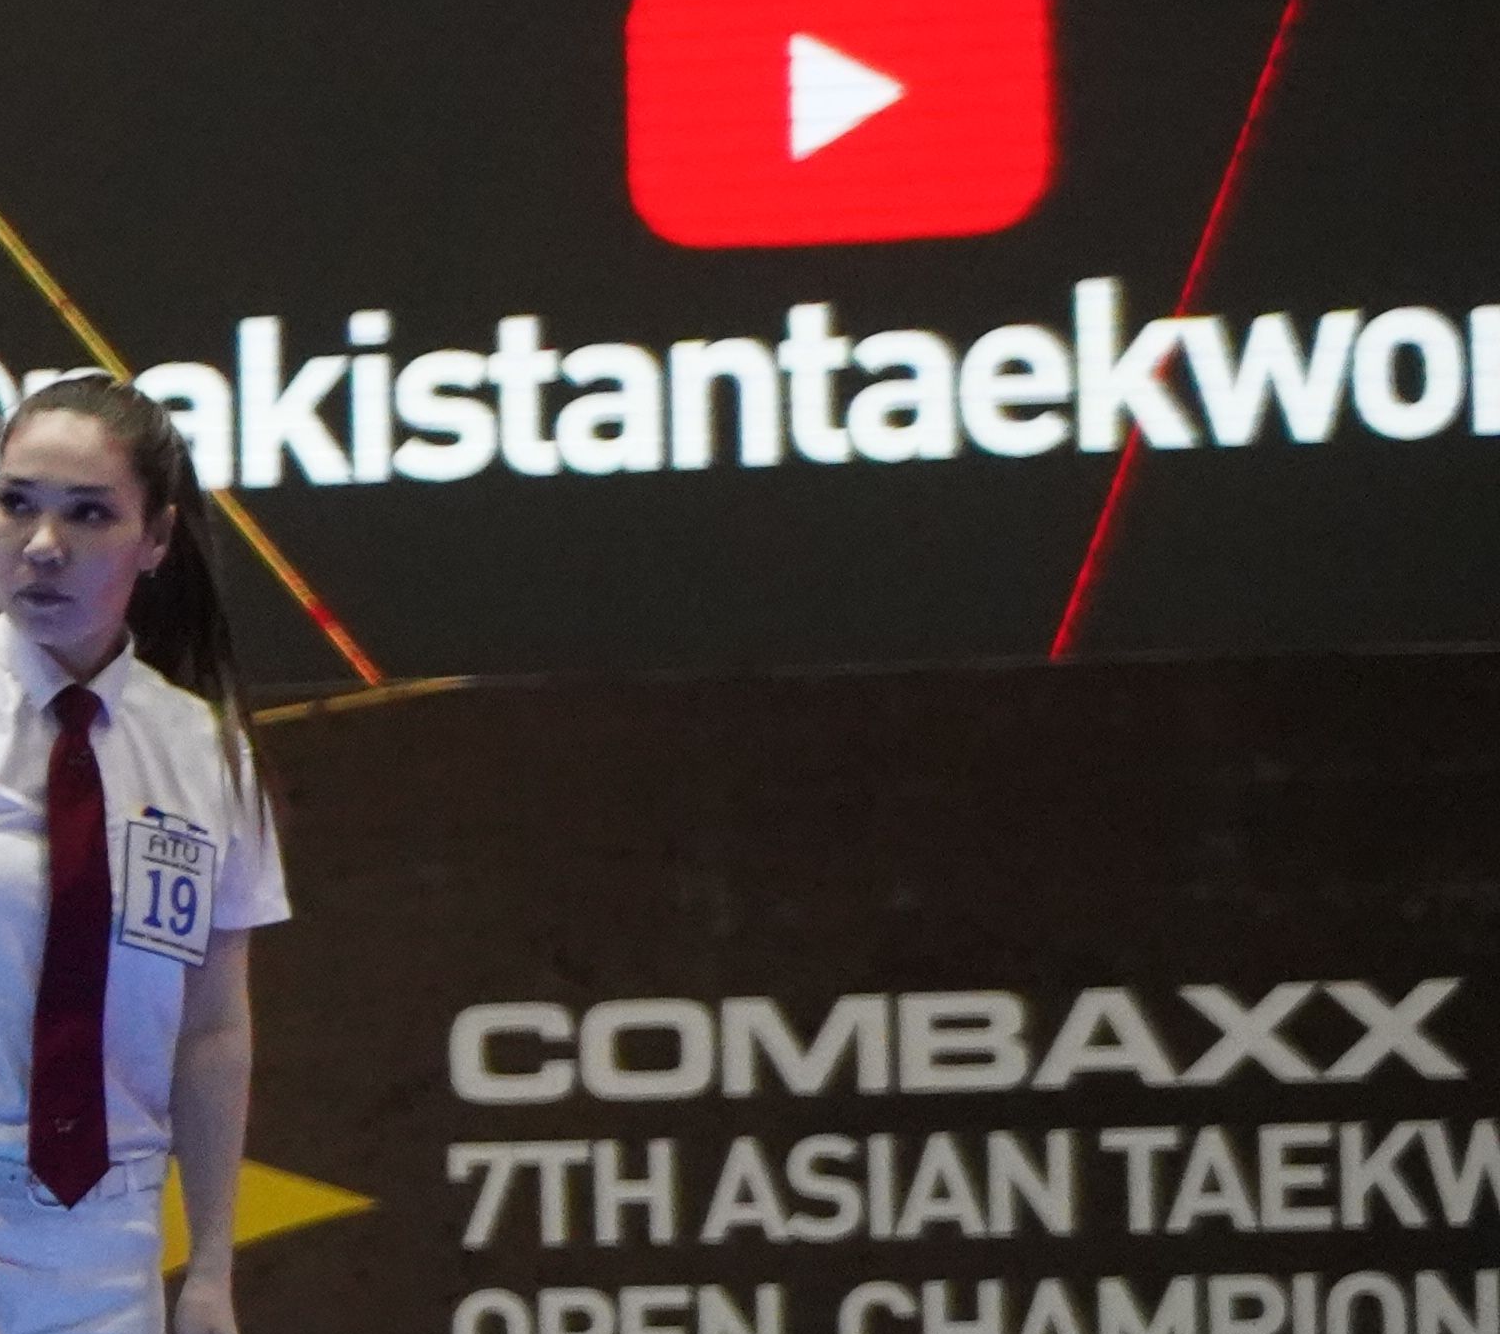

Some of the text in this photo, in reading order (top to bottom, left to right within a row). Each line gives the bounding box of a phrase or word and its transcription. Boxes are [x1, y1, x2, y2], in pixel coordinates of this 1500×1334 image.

[148, 833, 201, 866] ATU
[142, 870, 198, 937] 19
[447, 978, 1466, 1105] COMBAXX
[445, 1135, 678, 1250] 7TH
[700, 1127, 1078, 1244] ASIAN
